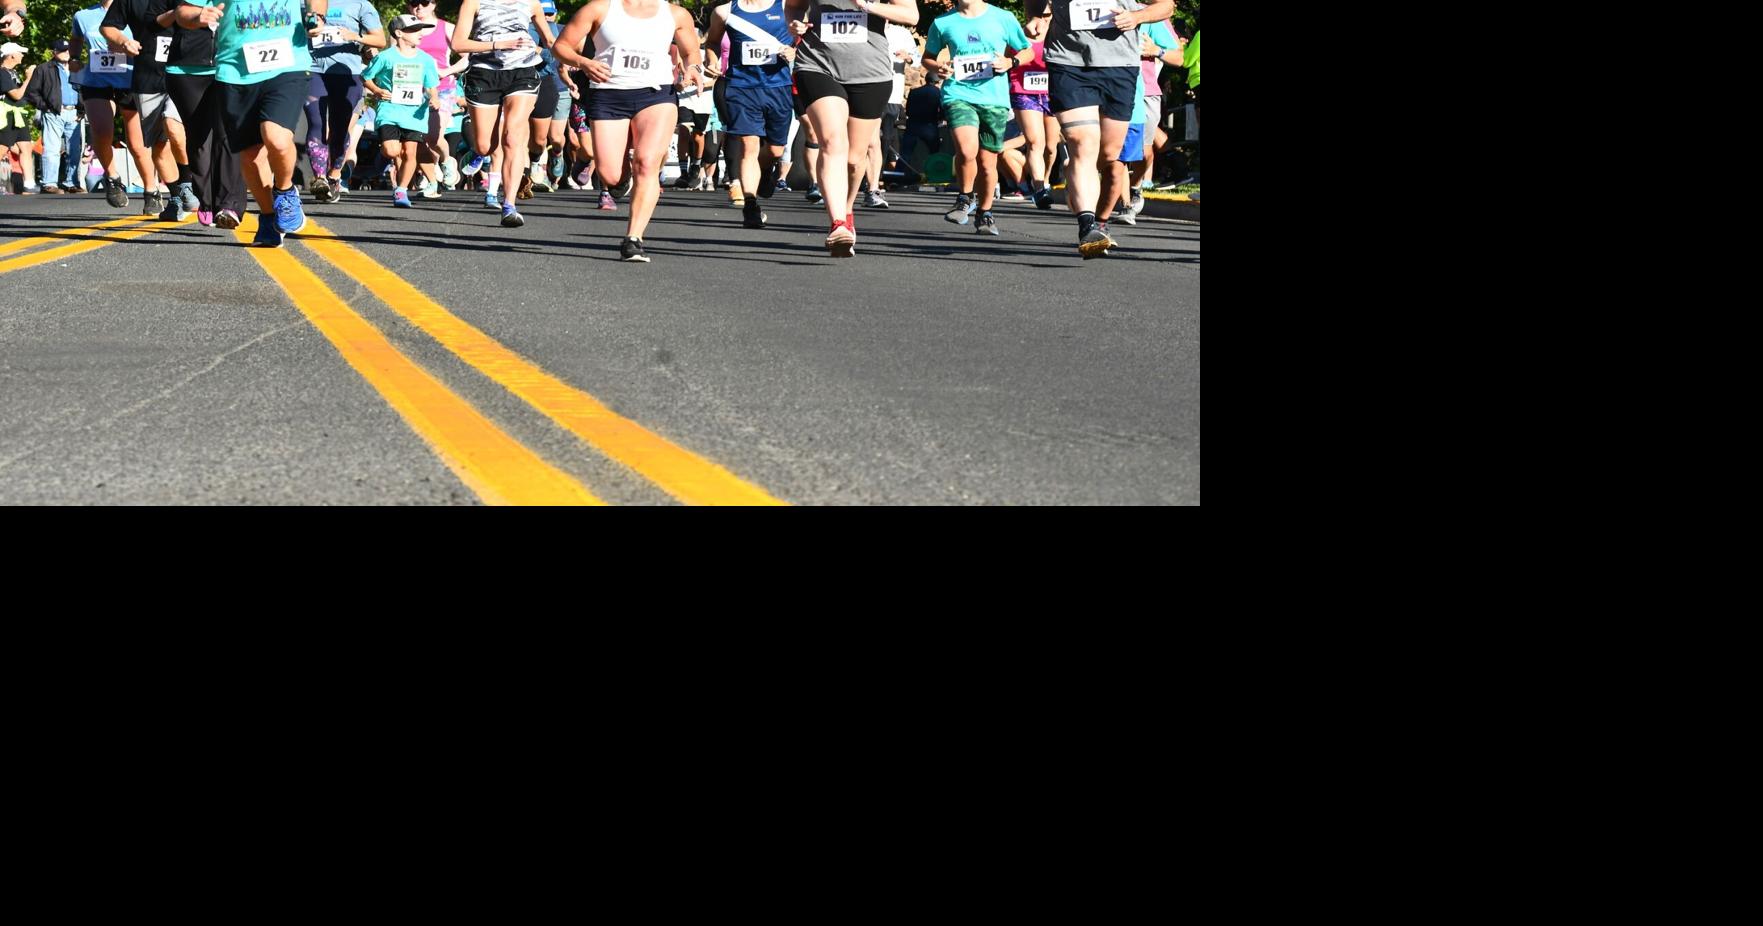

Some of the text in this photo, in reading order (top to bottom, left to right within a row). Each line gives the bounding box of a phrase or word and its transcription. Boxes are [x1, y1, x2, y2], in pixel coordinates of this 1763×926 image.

[1085, 8, 1100, 21] 17
[830, 20, 858, 34] 102
[259, 49, 279, 63] 22
[748, 48, 770, 59] 164
[100, 55, 116, 67] 37
[622, 55, 650, 70] 103
[961, 62, 984, 73] 144
[1030, 77, 1047, 85] 199
[402, 90, 414, 99] 74
